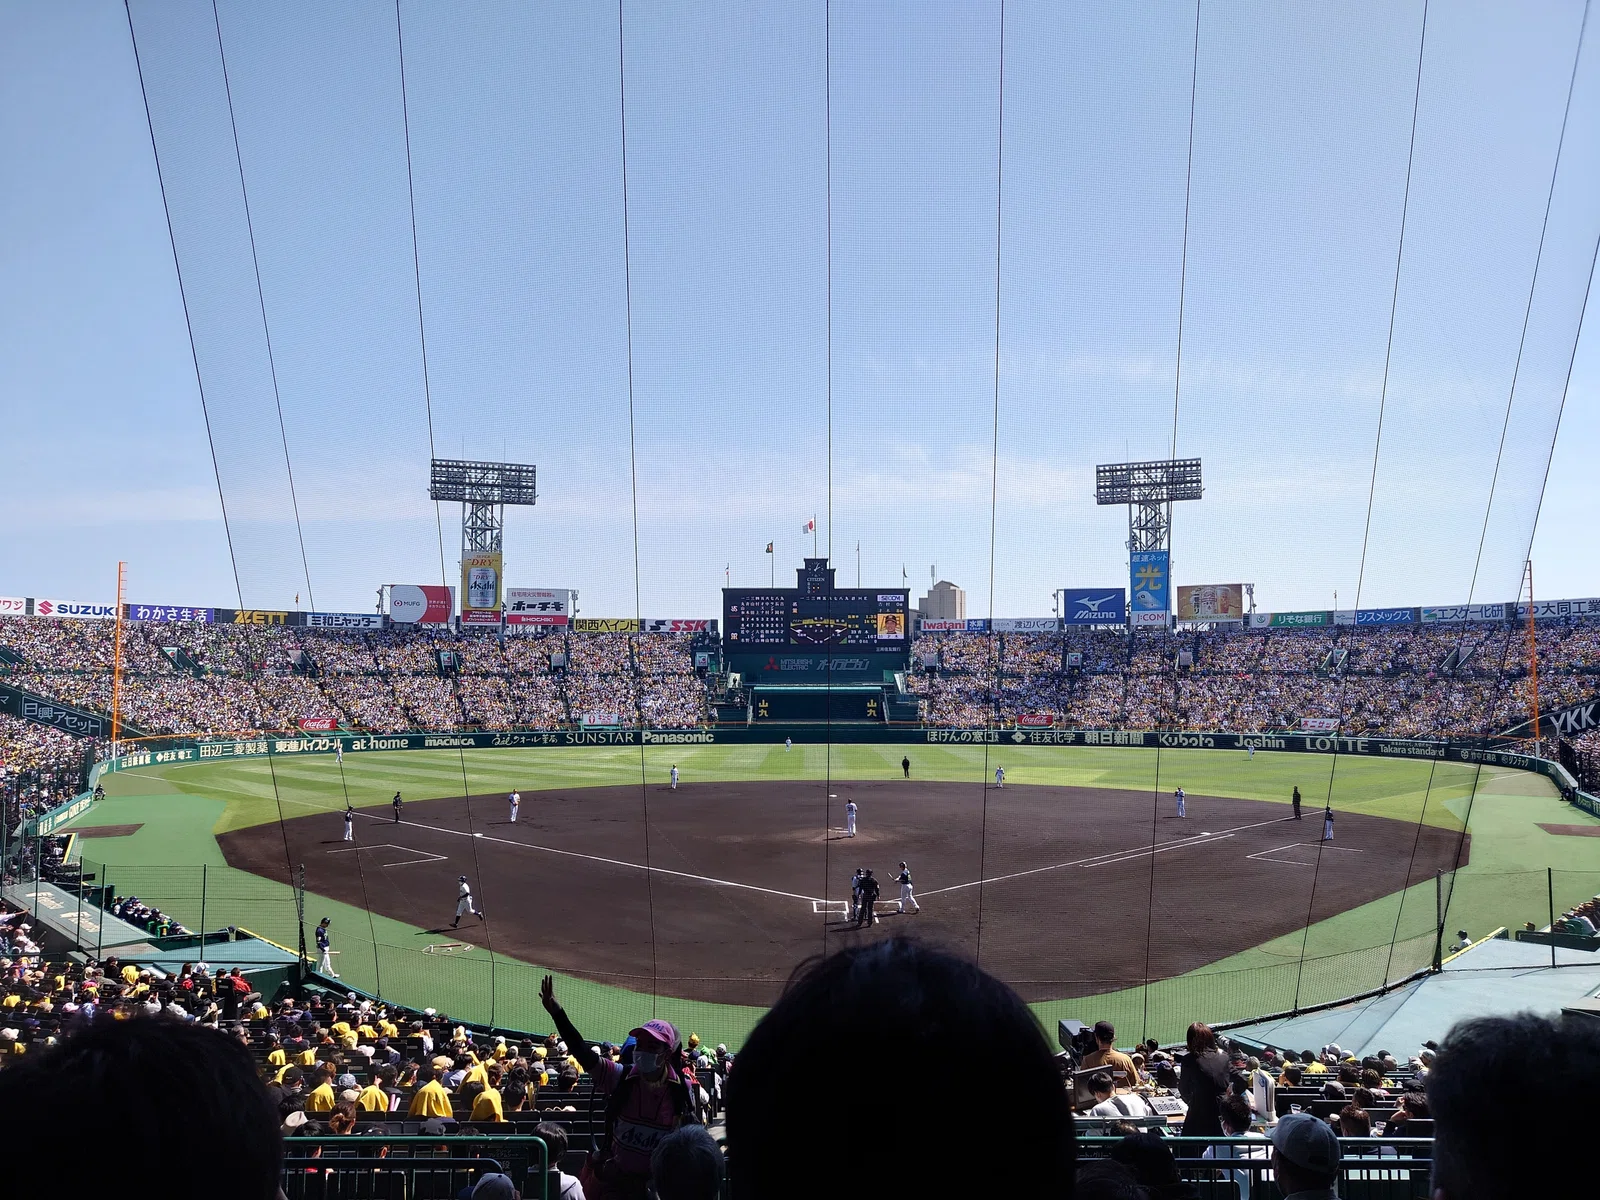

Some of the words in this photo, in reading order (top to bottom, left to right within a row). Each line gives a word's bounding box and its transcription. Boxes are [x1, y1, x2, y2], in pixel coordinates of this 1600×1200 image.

[1132, 554, 1168, 562] 超速ネット
[1134, 563, 1166, 591] 光
[470, 580, 494, 590] Asahi
[0, 600, 24, 610] ワジ
[512, 600, 564, 611] ホーチキ
[1541, 600, 1600, 616] 大同工業
[137, 606, 208, 622] わかさ生活
[234, 610, 288, 624] ZETT
[1074, 610, 1116, 619] MIZUNO
[1136, 614, 1165, 622] J:COM
[1358, 610, 1412, 622] シスメックス
[1437, 604, 1504, 620] エスケー化研
[312, 616, 378, 626] 三和シャッター
[575, 620, 638, 630] 関西ペイント
[923, 620, 966, 630] Iwatani
[1014, 620, 1056, 628] 渡辺パイプ
[1278, 614, 1322, 624] りそな銀行
[669, 620, 709, 631] SSK
[758, 699, 769, 717] 山九
[866, 699, 878, 717] 山九
[24, 702, 100, 734] 日興アセット
[1550, 704, 1596, 737] YKK
[566, 732, 634, 744] SUNSTAR
[642, 731, 714, 743] Panasonic
[927, 731, 994, 742] ほけんの窓口
[1029, 732, 1076, 743] 住友化学
[1084, 732, 1144, 745] 朝日新聞
[1159, 734, 1214, 747] Kubota
[1234, 735, 1286, 748] Joshin
[275, 738, 343, 752] 東進ハイスクール
[352, 739, 366, 750] at
[368, 736, 408, 749] home
[1306, 738, 1369, 752] LOTTE
[200, 742, 268, 758] 田辺三菱製薬
[1378, 744, 1406, 754] Takara
[1408, 746, 1445, 756] standard
